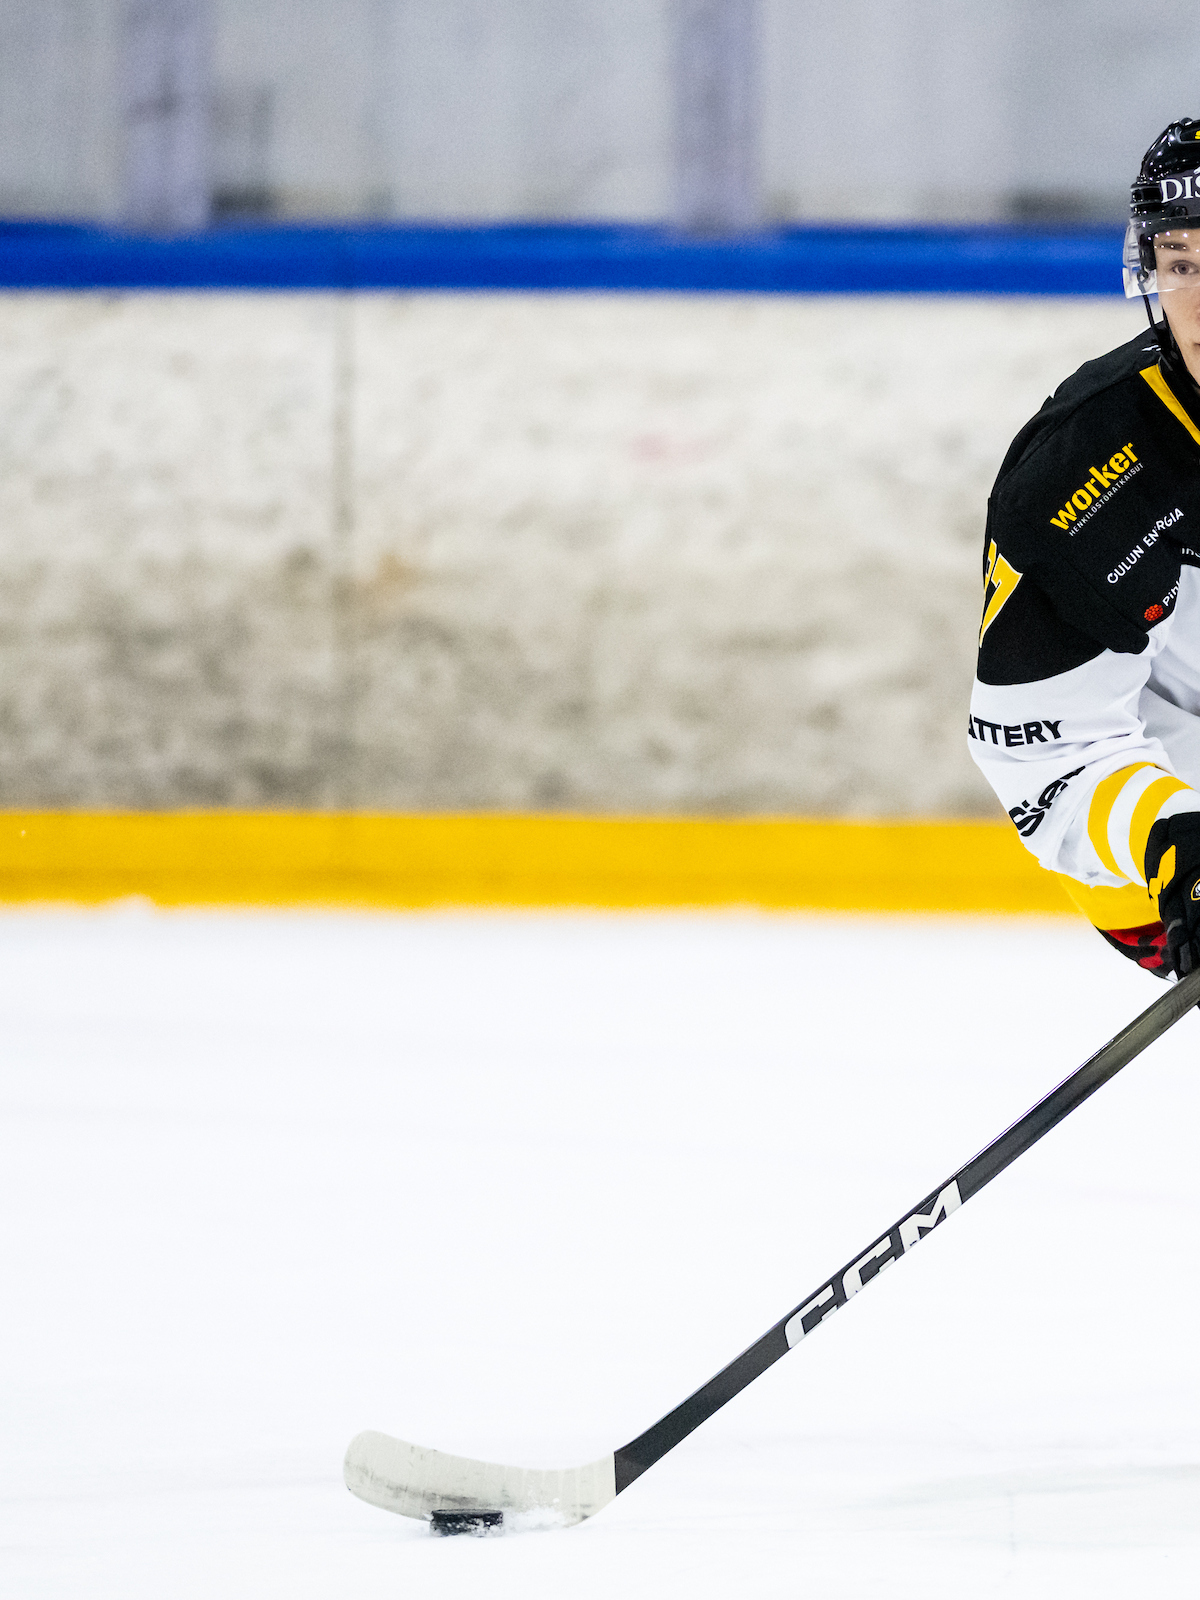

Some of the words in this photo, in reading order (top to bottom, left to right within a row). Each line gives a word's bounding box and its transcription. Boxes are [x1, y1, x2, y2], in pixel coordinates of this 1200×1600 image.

[1049, 442, 1139, 530] worker
[1107, 544, 1145, 584] OULUN
[1143, 508, 1184, 547] ENRGIA
[784, 1179, 963, 1349] CCM
